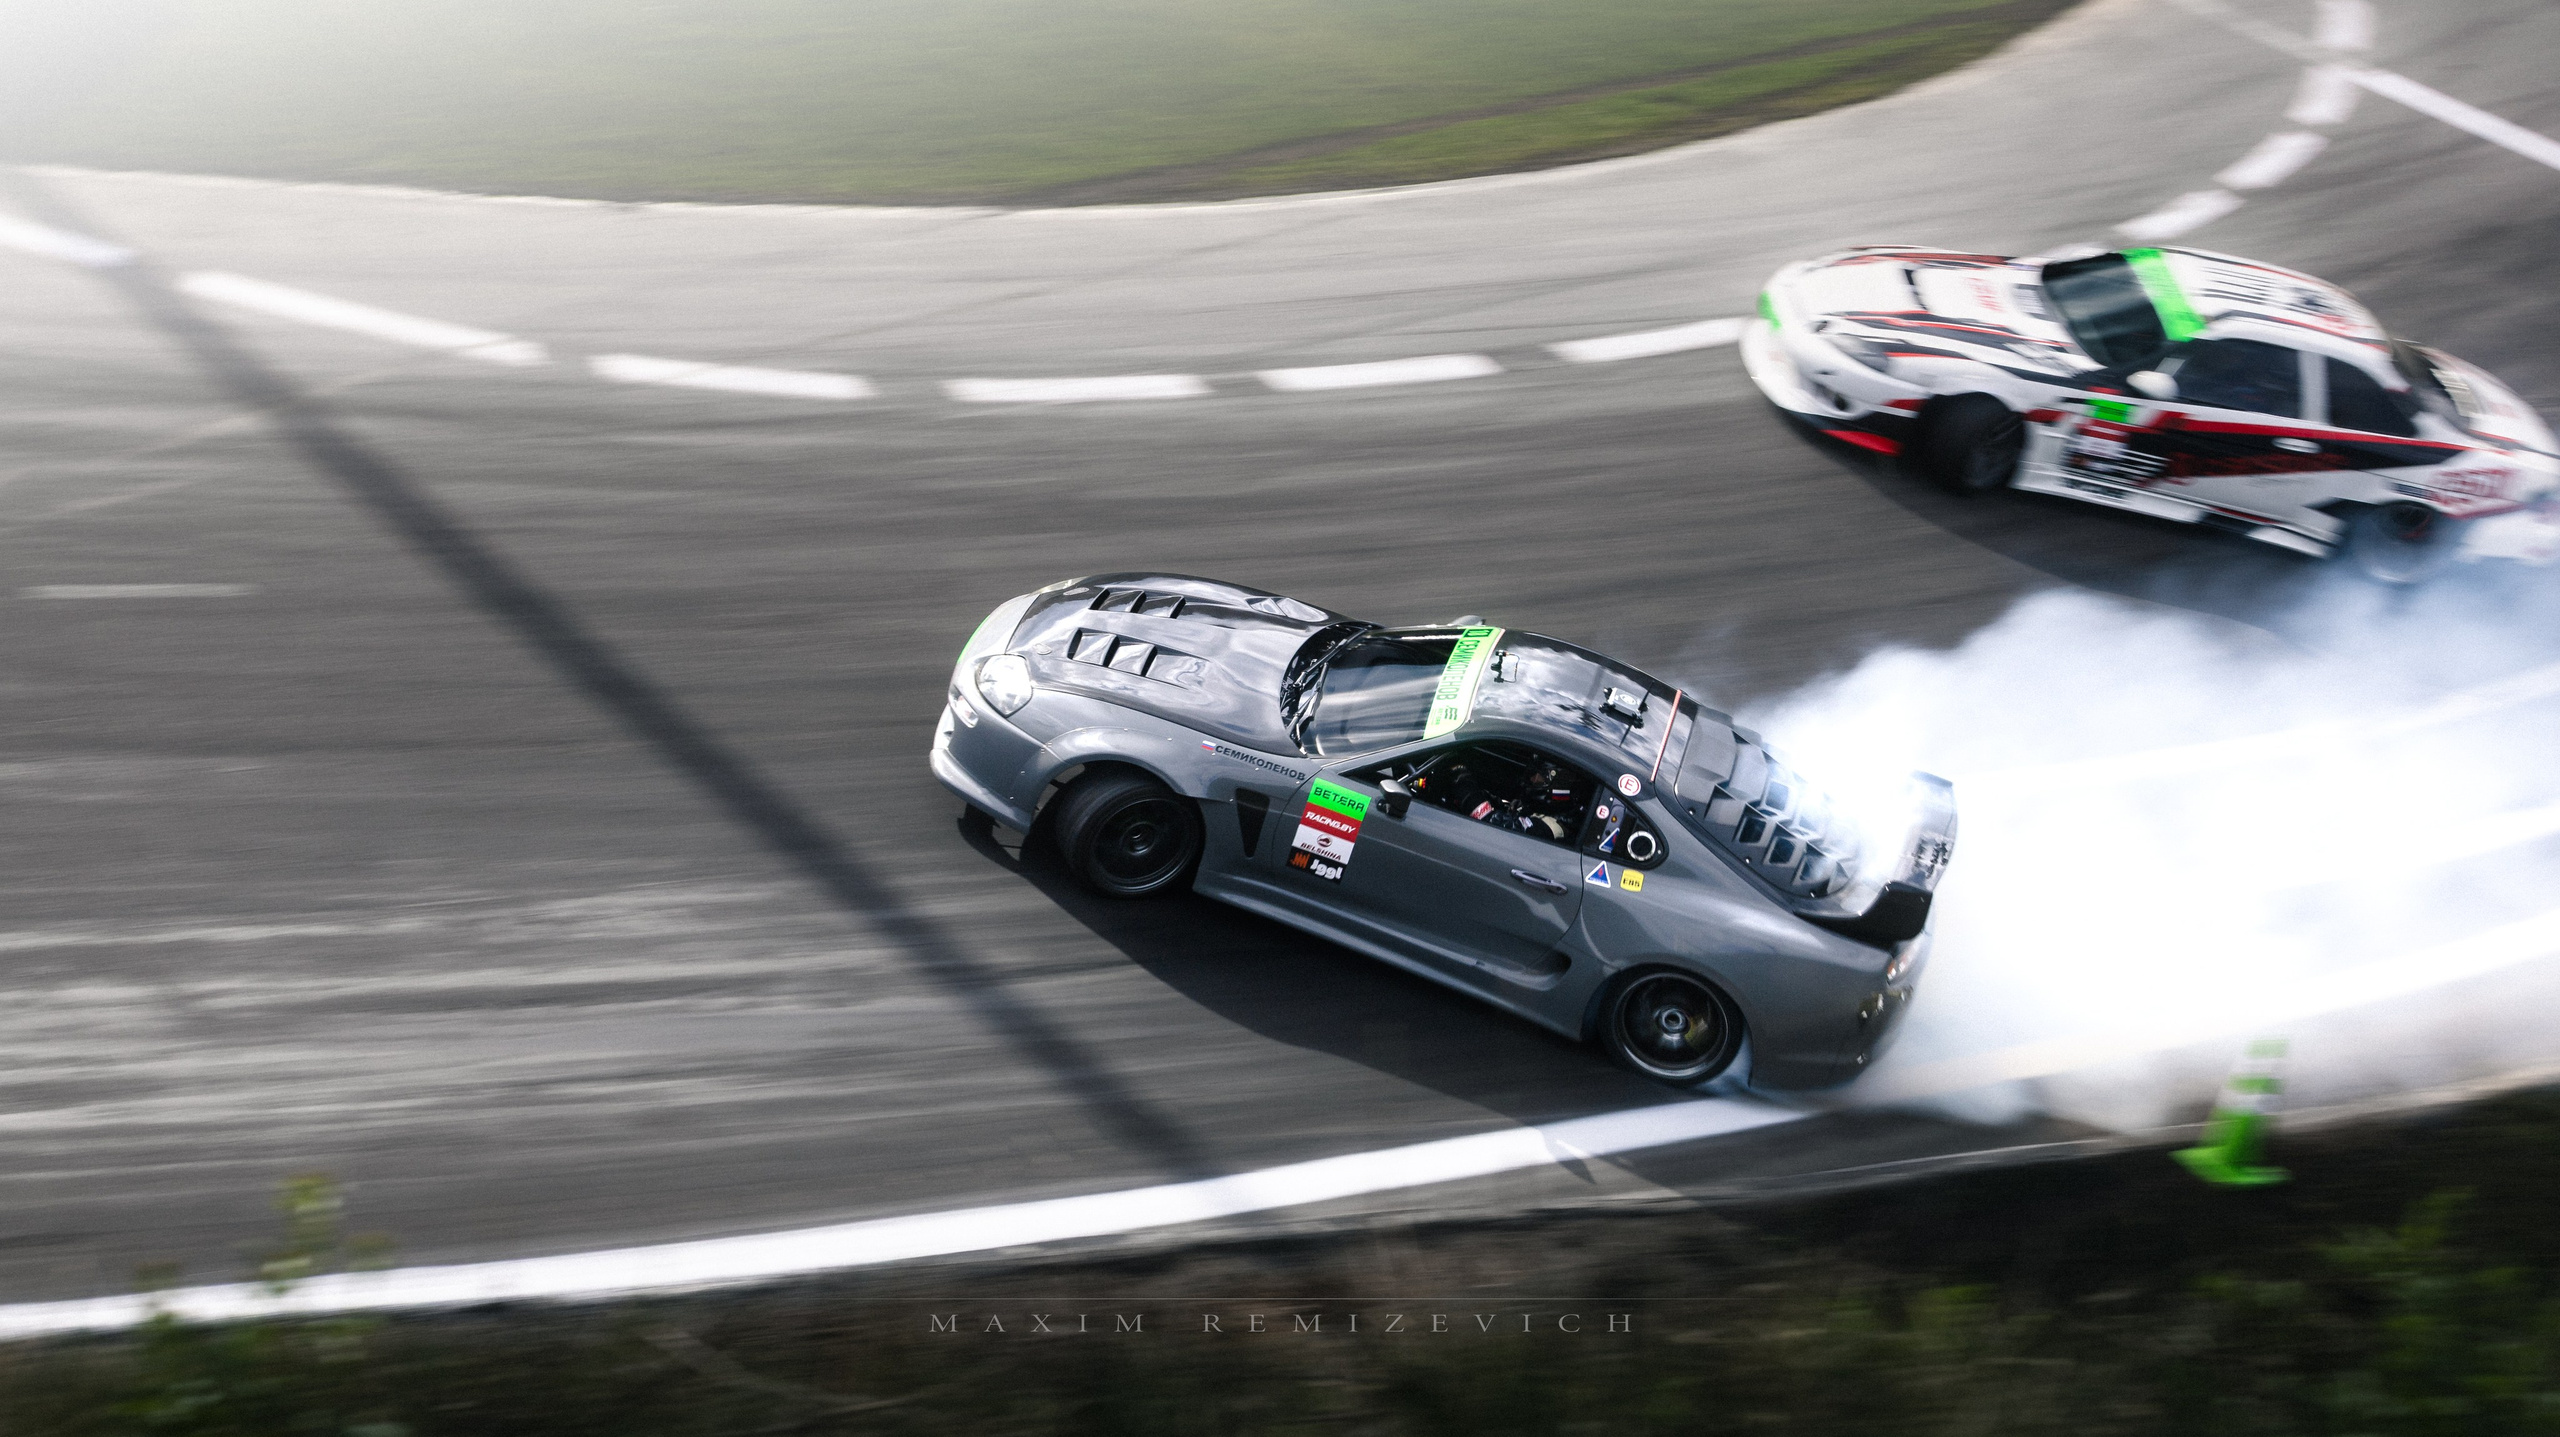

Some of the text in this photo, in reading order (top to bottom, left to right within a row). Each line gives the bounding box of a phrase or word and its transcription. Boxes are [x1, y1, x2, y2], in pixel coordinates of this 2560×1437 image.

[1215, 745, 1306, 781] СЕМИКОЛЕНОВ
[1624, 778, 1635, 792] E
[1314, 787, 1365, 812] BETERA
[1305, 811, 1356, 833] RACING.BY
[1301, 842, 1342, 860] BELSHINA
